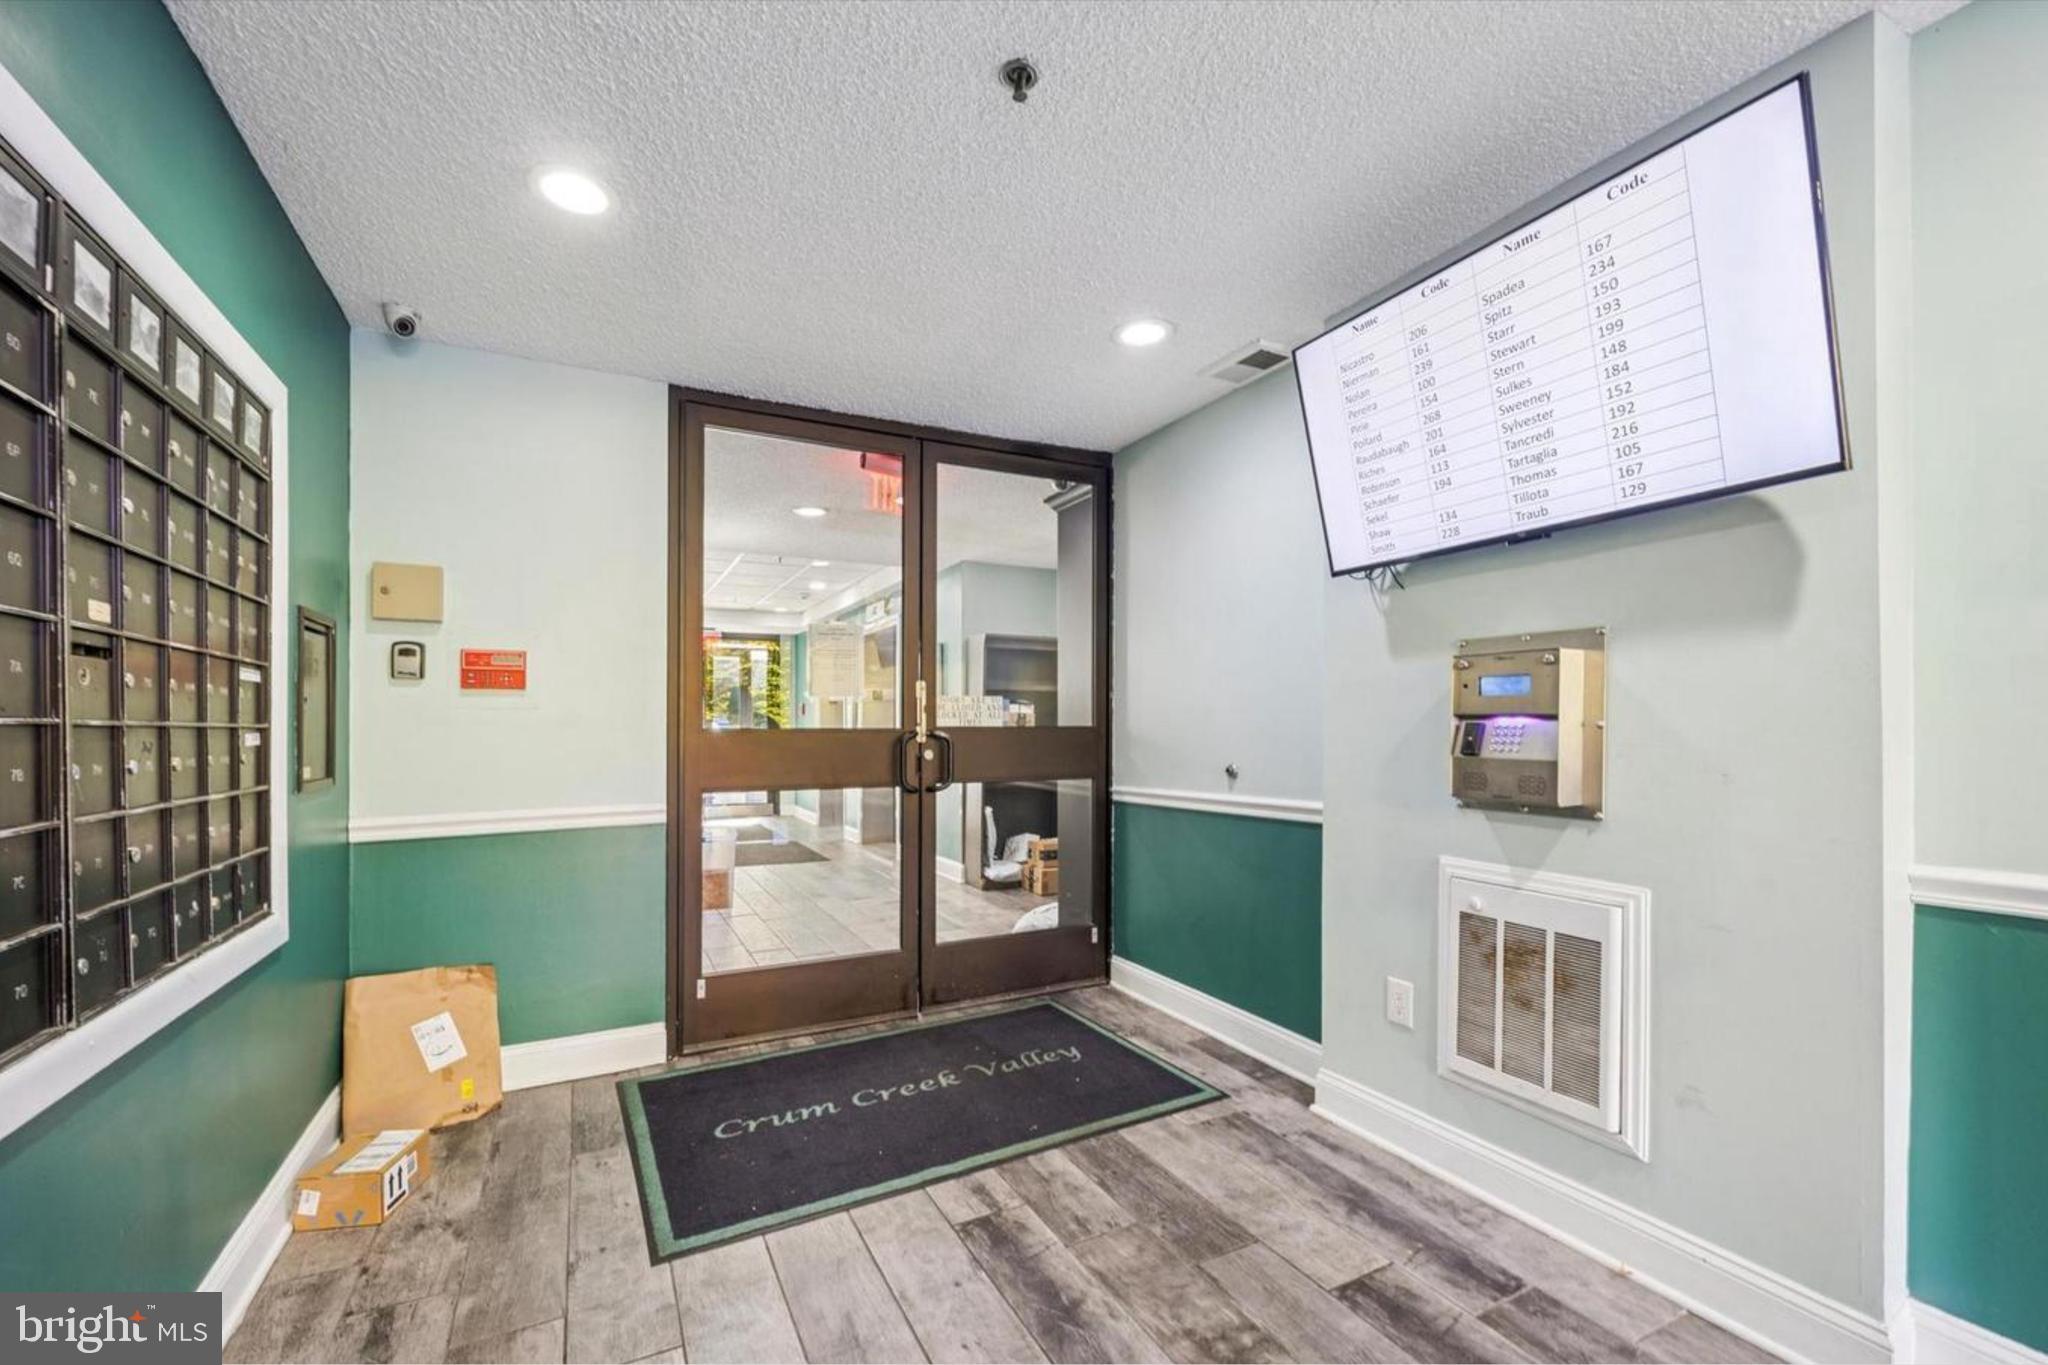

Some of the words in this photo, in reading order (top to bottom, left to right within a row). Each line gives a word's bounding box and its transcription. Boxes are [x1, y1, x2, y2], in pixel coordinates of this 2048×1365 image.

[1351, 316, 1379, 334] Name
[1420, 276, 1451, 300] Code
[1502, 228, 1541, 257] Name
[1607, 171, 1650, 202] Code
[1408, 324, 1428, 341] 206
[1481, 279, 1526, 306] Spadea
[1587, 234, 1613, 257] 167
[1411, 343, 1430, 358] 161
[1484, 305, 1512, 326] Spitz
[1589, 255, 1616, 278] 234
[1414, 360, 1433, 375] 239
[1487, 324, 1516, 344] Starr
[1592, 277, 1619, 298] 150
[1417, 376, 1436, 392] 100
[1490, 334, 1537, 362] Stewart
[1595, 298, 1622, 319] 193
[1420, 393, 1438, 408] 154
[1493, 360, 1524, 380] Stern
[1598, 318, 1624, 339] 199
[1423, 410, 1441, 425] 268
[1495, 377, 1533, 398] Sulkes
[1601, 339, 1627, 360] 148
[1425, 427, 1444, 442] 201
[1498, 391, 1552, 417] Sweeney
[1604, 360, 1630, 379] 184
[1428, 443, 1447, 458] 164
[1501, 409, 1554, 435] Sylvester
[1607, 381, 1633, 400] 152
[1431, 460, 1450, 474] 113
[1504, 427, 1554, 452] Tancredi
[1609, 401, 1636, 420] 192
[1434, 477, 1452, 491] 194
[1507, 447, 1558, 470] Tartaglia
[1612, 421, 1639, 440] 216
[1439, 510, 1458, 523] 134
[1512, 488, 1550, 506] Tillota
[1618, 461, 1644, 479] 167
[1510, 467, 1558, 488] Thomas
[1615, 441, 1641, 460] 105
[1442, 526, 1461, 539] 228
[1515, 505, 1549, 522] Traub
[1620, 480, 1647, 498] 129
[713, 1100, 841, 1140] Crum
[851, 1069, 962, 1108] Creek
[963, 1045, 1083, 1078] Valley
